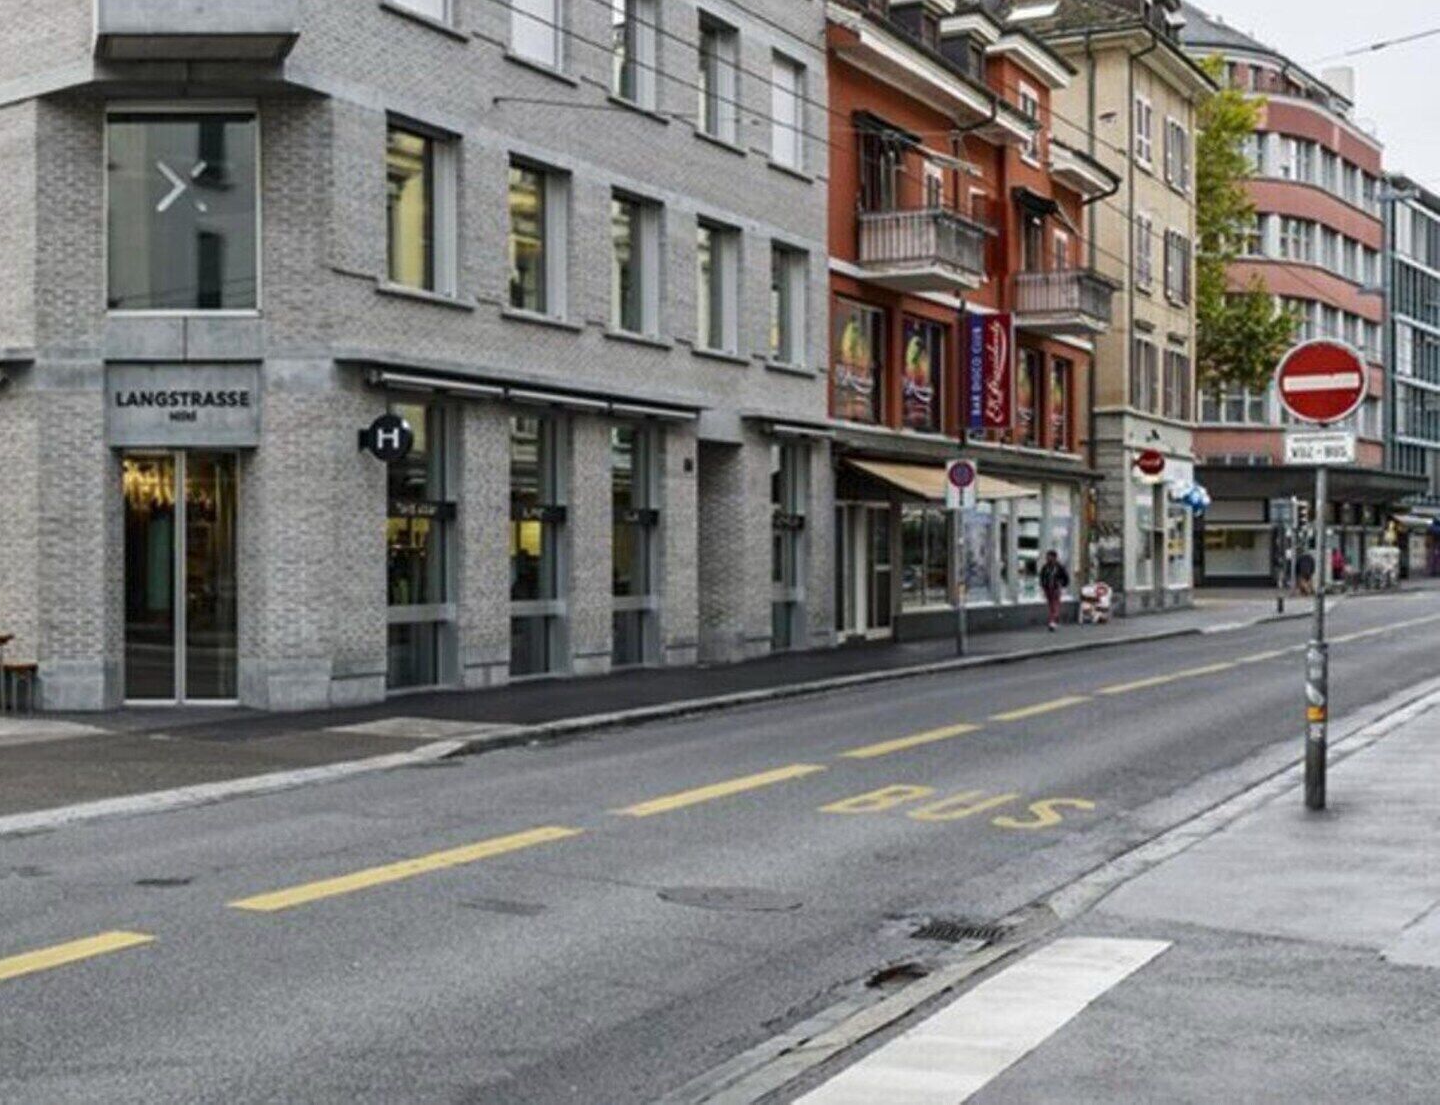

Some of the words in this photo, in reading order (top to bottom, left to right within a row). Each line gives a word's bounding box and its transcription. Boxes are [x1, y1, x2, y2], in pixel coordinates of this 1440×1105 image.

[116, 390, 250, 408] LANGSTRASSE
[377, 428, 399, 449] H
[818, 784, 1096, 829] BUS
